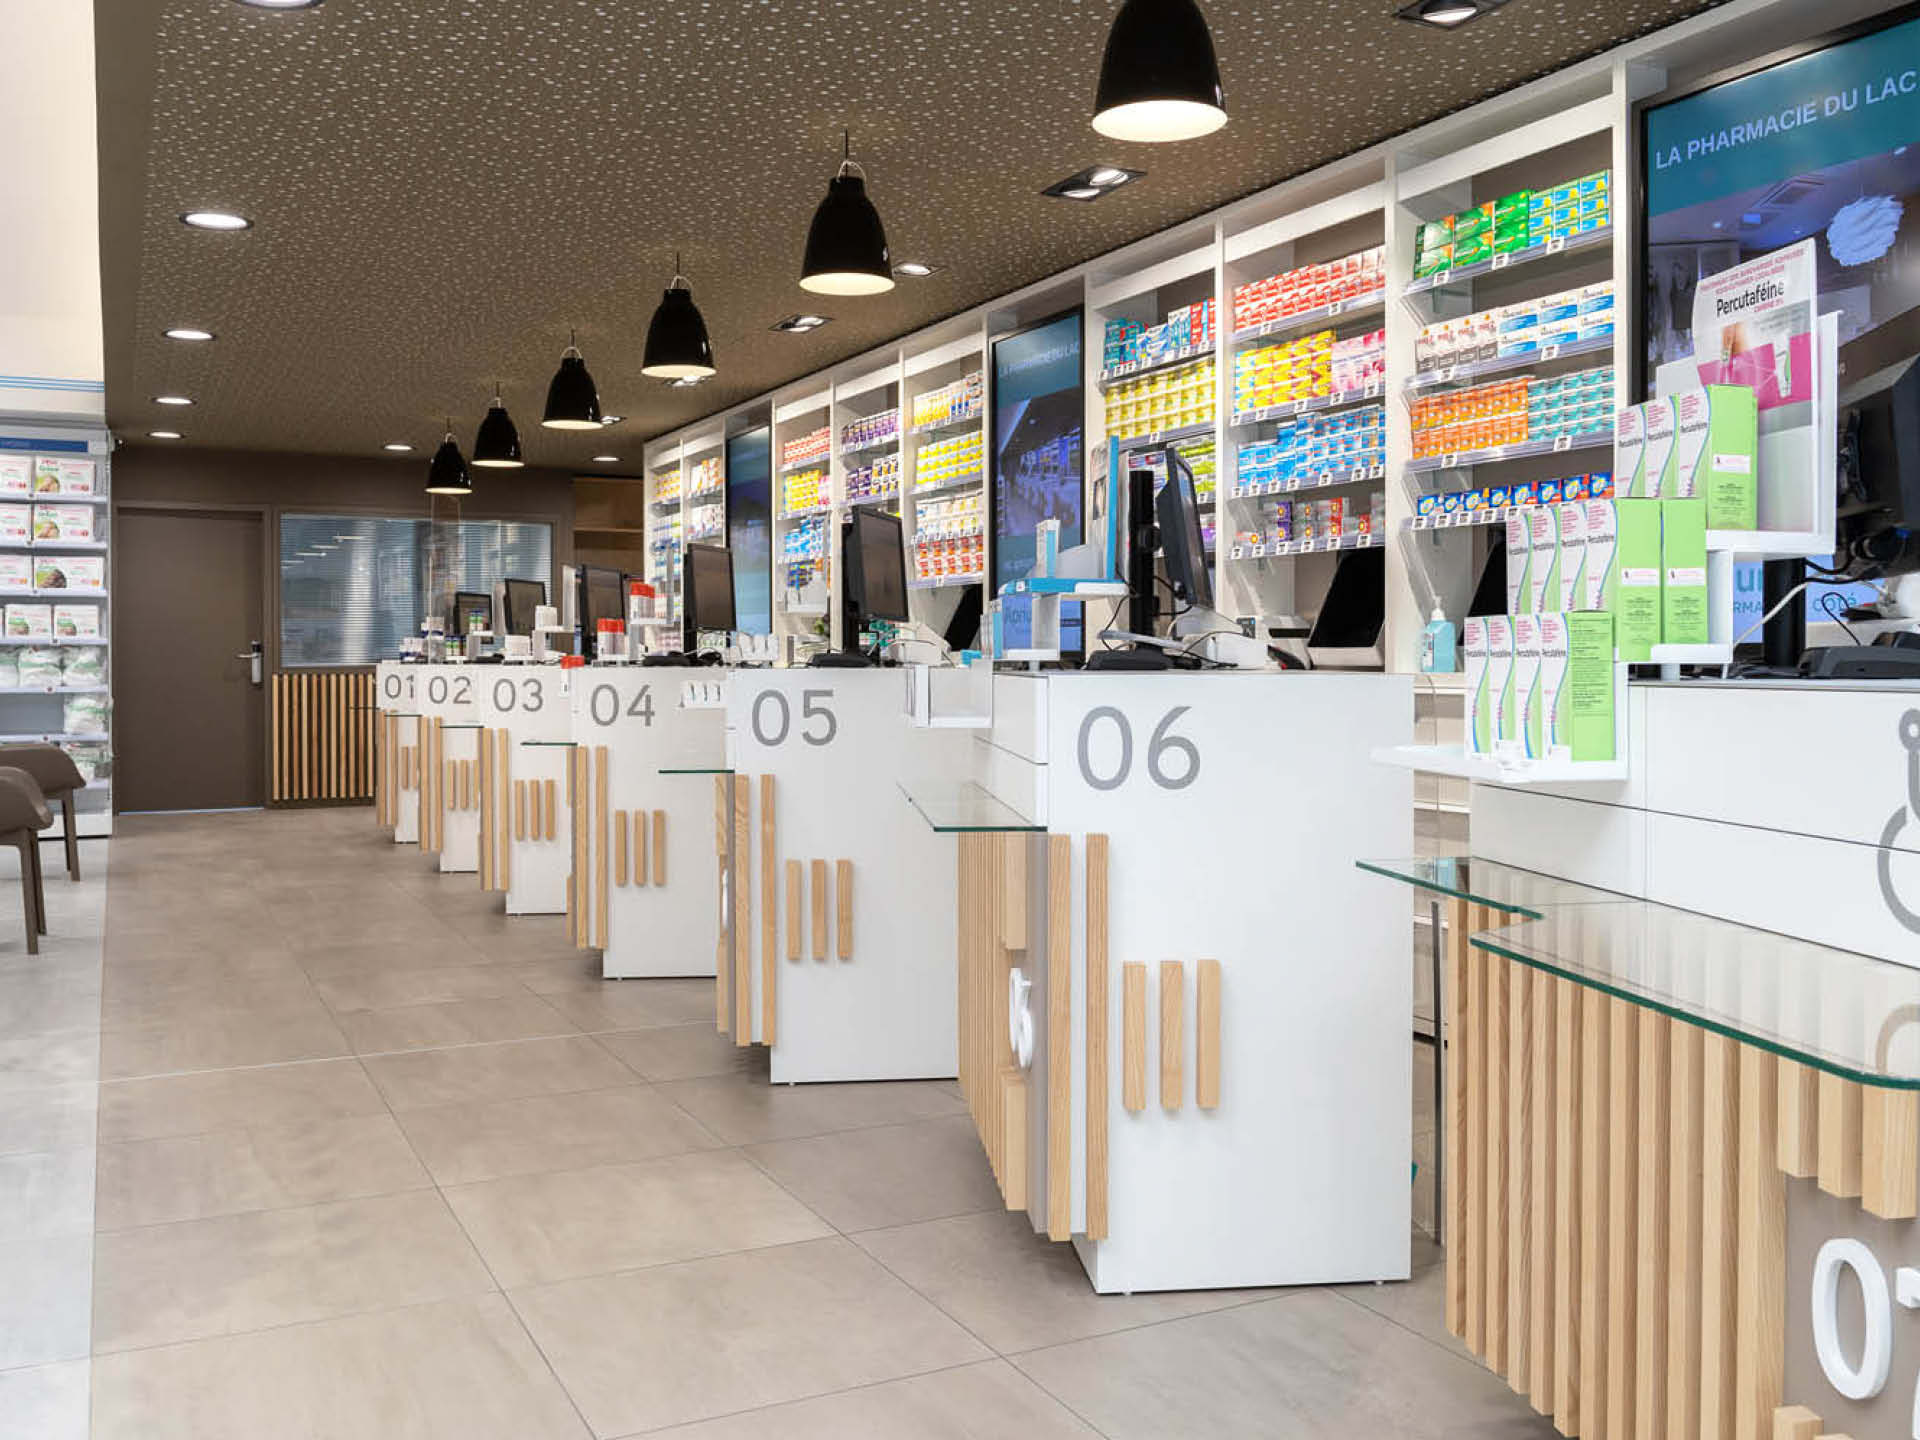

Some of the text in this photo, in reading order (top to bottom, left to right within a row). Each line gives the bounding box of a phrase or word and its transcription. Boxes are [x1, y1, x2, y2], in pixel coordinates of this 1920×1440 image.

[1655, 71, 1917, 169] LA PHARMACIE DU LAC
[1716, 281, 1785, 318] Percutaféine
[384, 674, 415, 699] 01
[429, 675, 471, 704] 02
[493, 678, 543, 713] 03
[591, 684, 655, 727] 04
[751, 689, 837, 747] 05
[1077, 705, 1201, 791] 06
